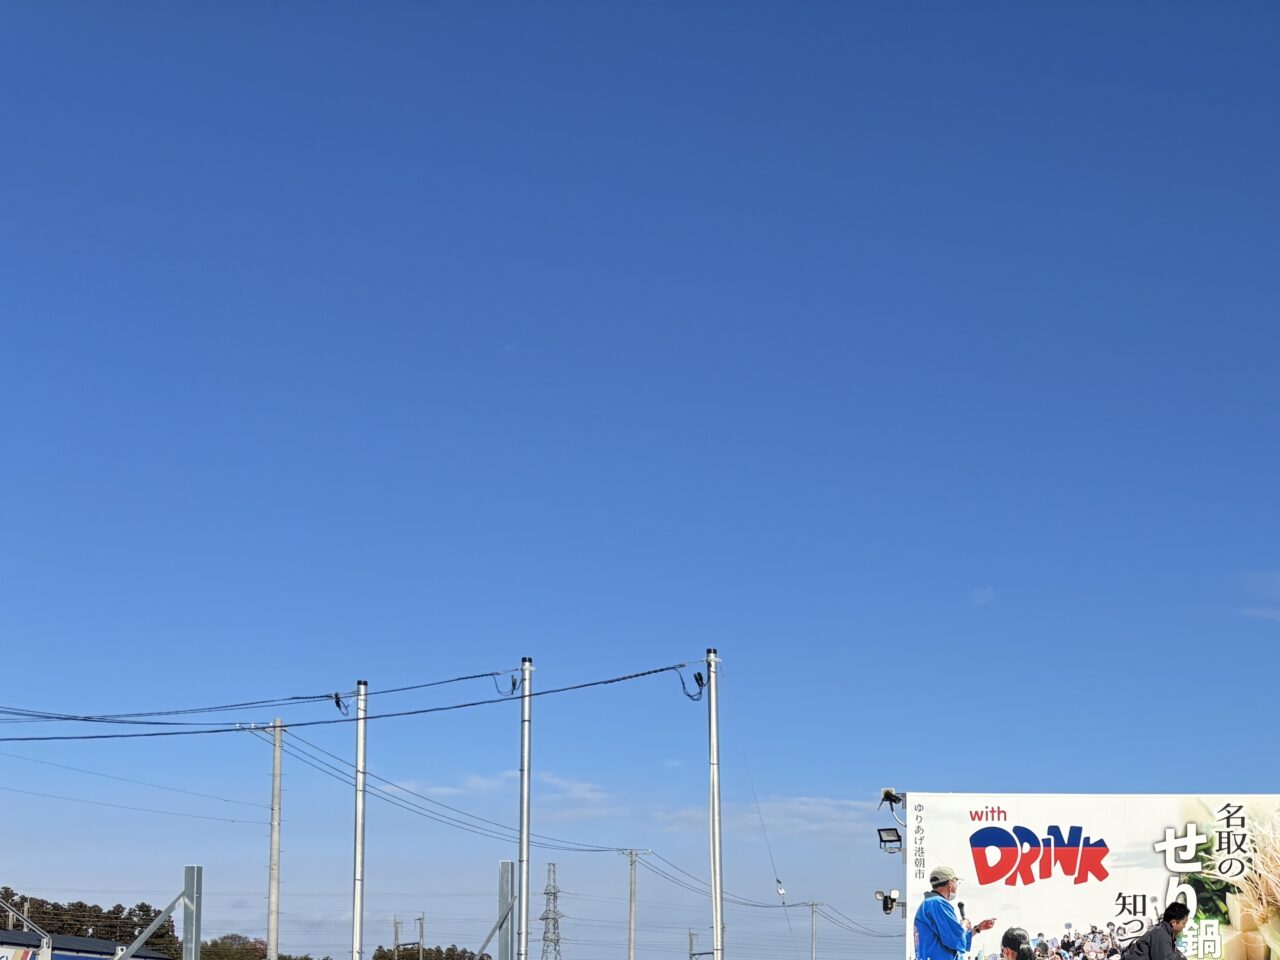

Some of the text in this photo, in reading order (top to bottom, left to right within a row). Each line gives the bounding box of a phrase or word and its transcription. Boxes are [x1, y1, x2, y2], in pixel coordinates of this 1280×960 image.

[913, 803, 925, 880] ゆりあげ港朝市
[969, 805, 1007, 822] with
[1216, 802, 1246, 878] 名取の
[968, 825, 1110, 887] DRINK
[1114, 892, 1146, 942] 知っ
